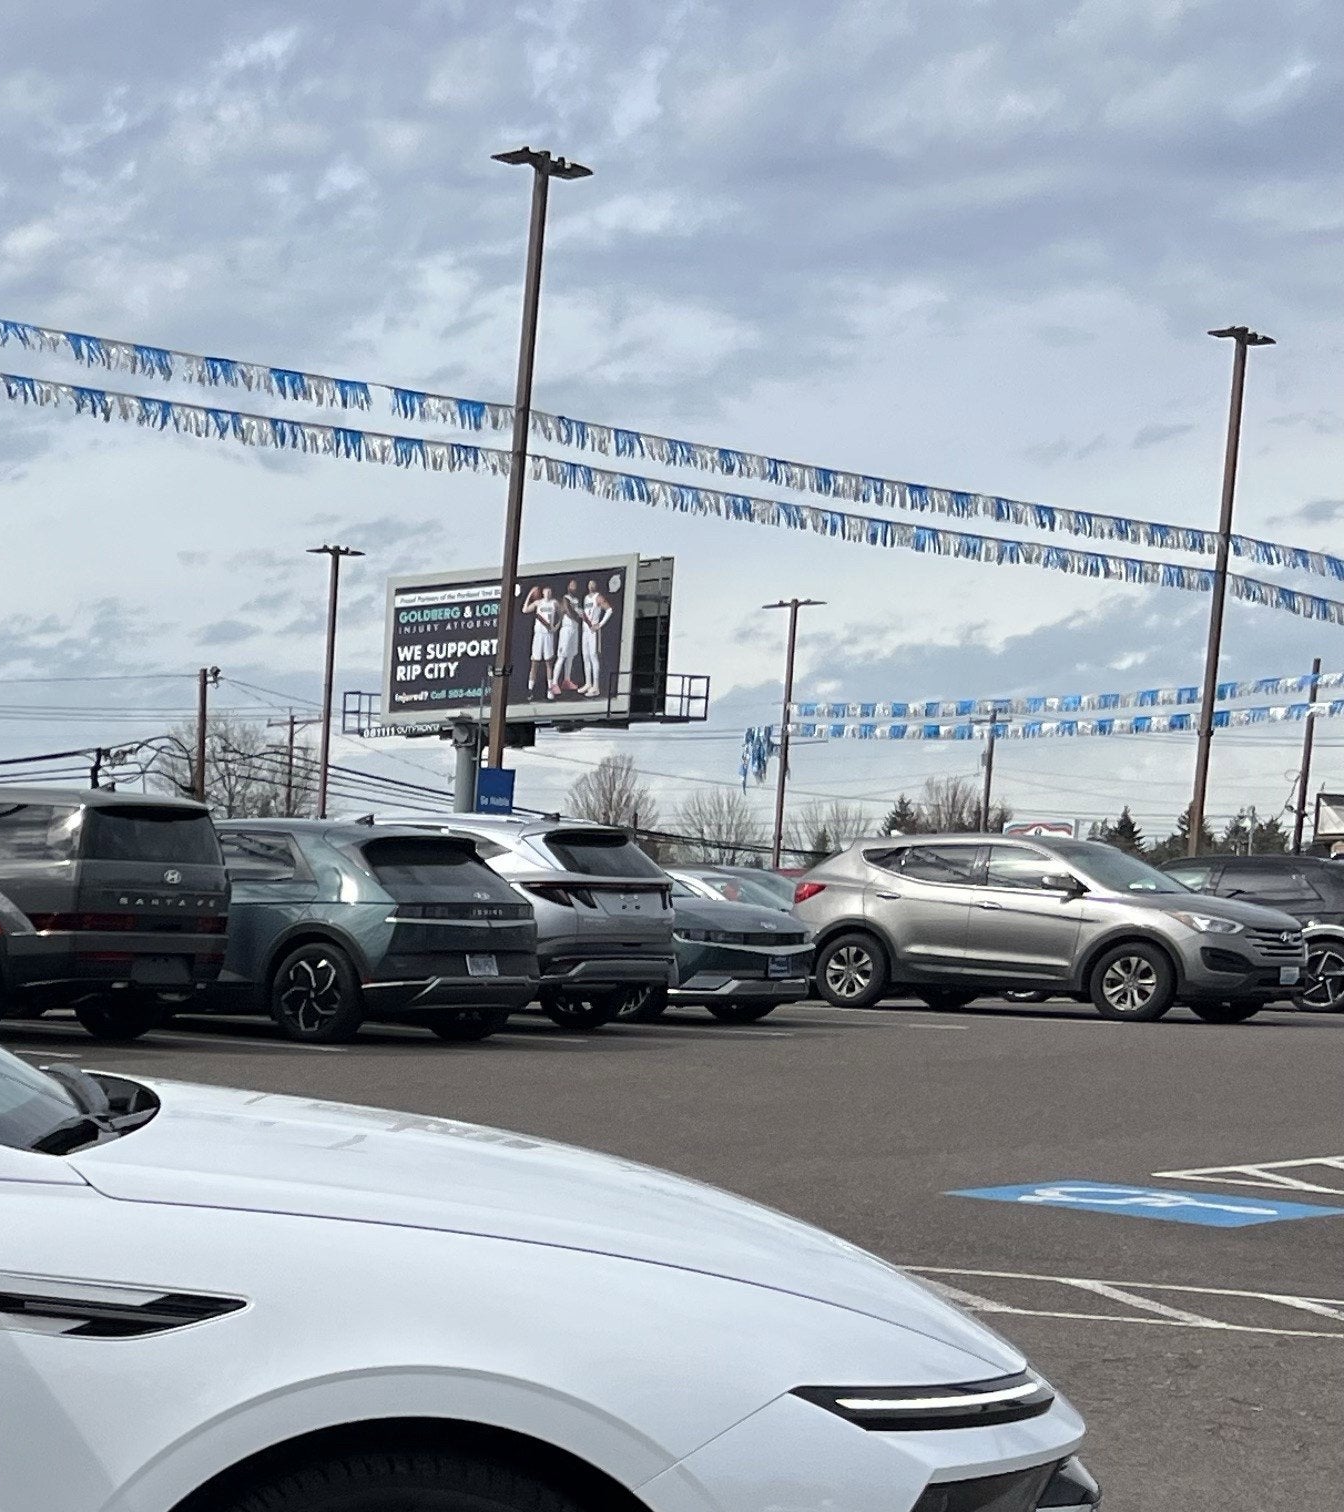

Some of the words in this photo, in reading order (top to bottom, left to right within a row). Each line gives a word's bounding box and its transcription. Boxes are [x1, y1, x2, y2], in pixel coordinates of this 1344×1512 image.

[398, 606, 461, 624] GOLDBERG
[463, 605, 472, 618] &
[398, 623, 440, 635] INJURY
[397, 644, 422, 662] WE
[426, 639, 499, 660] SUPPORT
[396, 664, 421, 681] RIP
[424, 661, 459, 679] CITY
